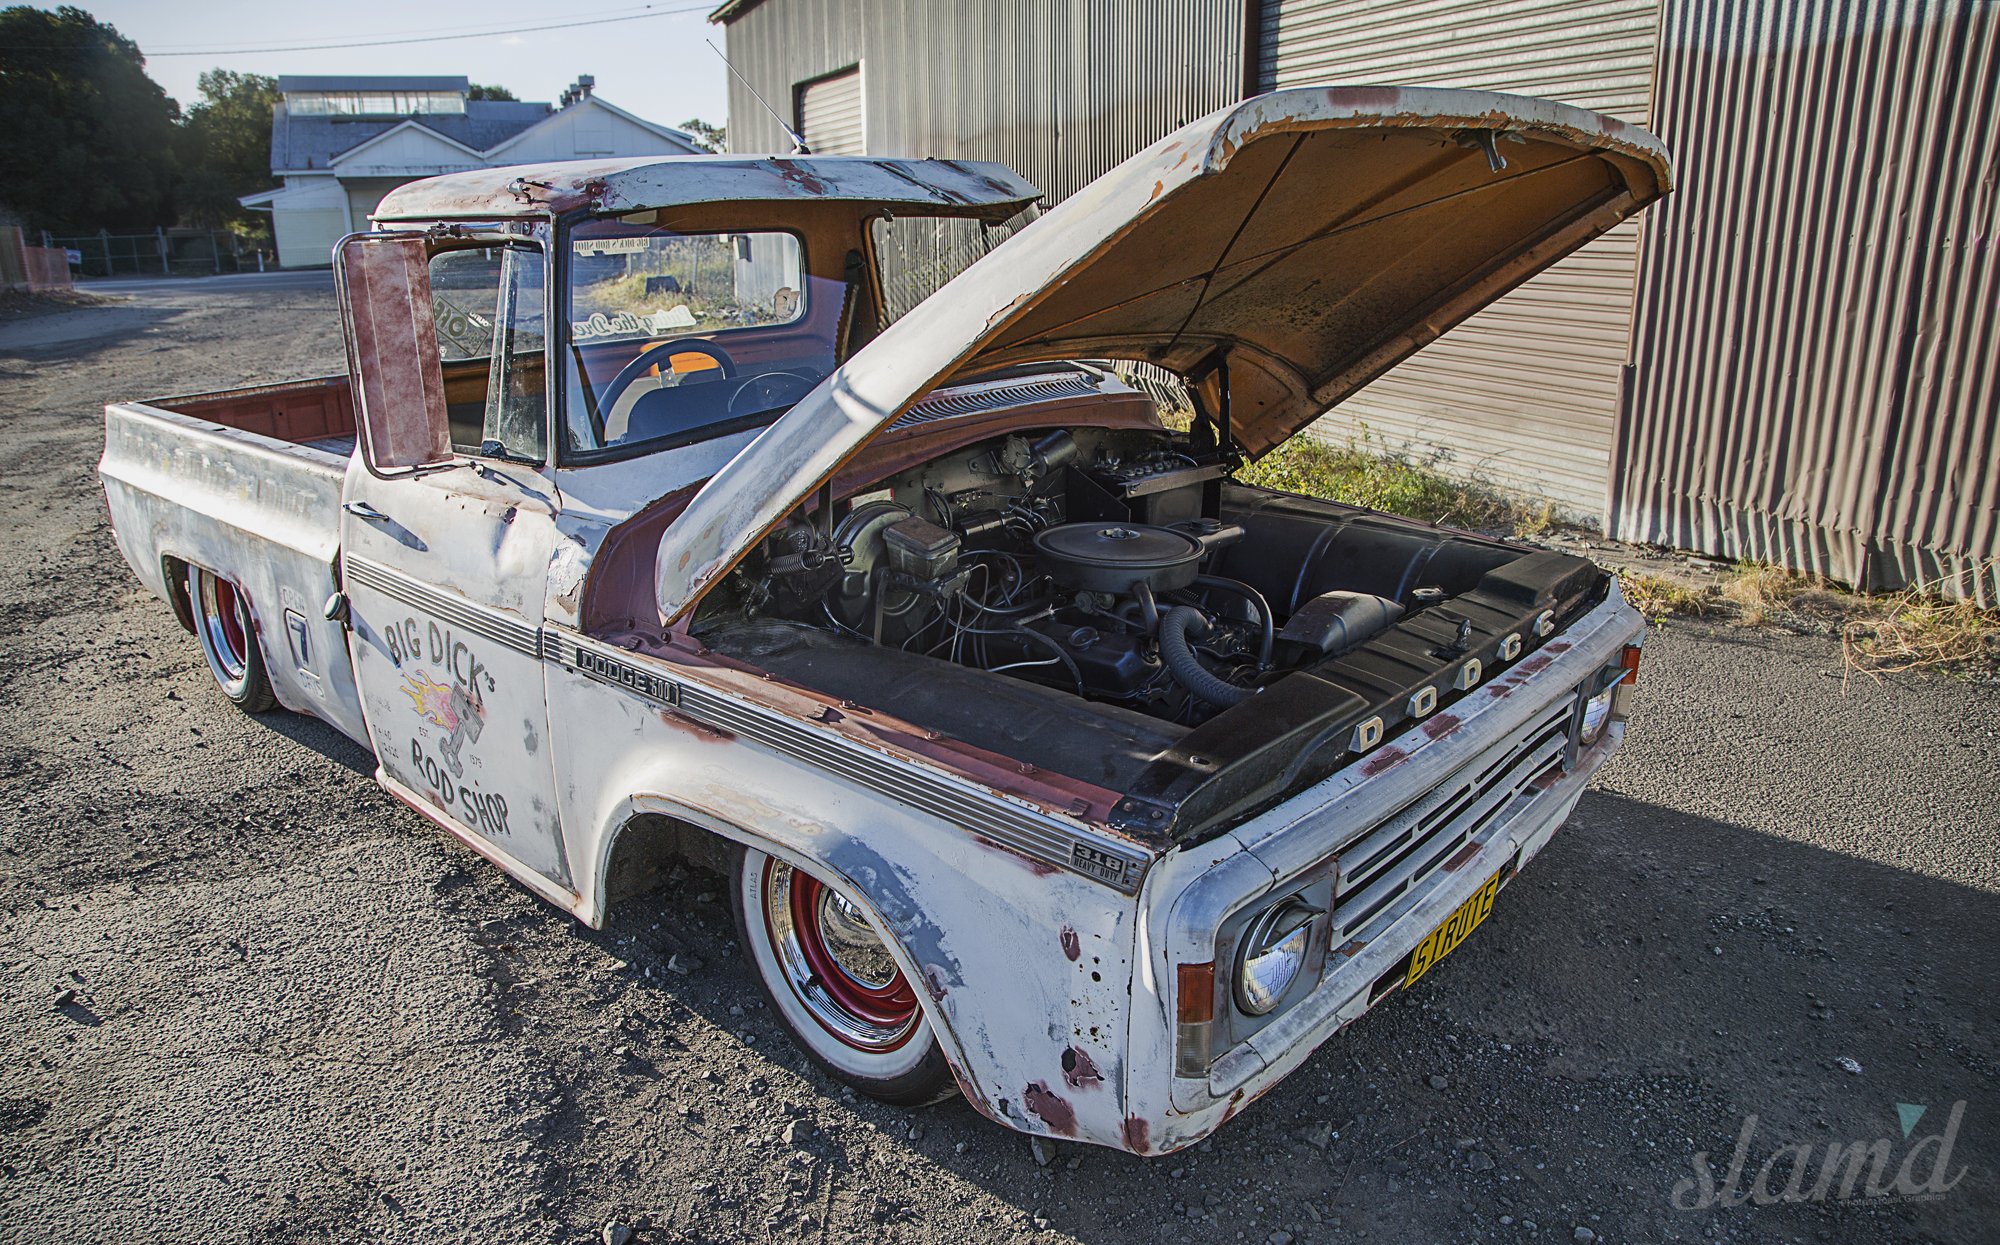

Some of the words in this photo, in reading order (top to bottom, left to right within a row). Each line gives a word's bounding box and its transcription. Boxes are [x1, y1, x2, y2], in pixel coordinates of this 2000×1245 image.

[282, 588, 305, 611] OPEN
[289, 616, 309, 666] 7
[384, 617, 422, 666] BIG
[299, 672, 325, 698] DAYS
[581, 650, 648, 691] DODGE
[651, 677, 671, 701] 600
[1349, 609, 1555, 753] DODGE
[410, 737, 455, 805] ROD
[458, 784, 512, 836] SHOP
[1074, 858, 1096, 873] HEAVY
[1099, 867, 1119, 882] DUTY
[1076, 847, 1121, 871] 318
[749, 872, 758, 899] ATLAS
